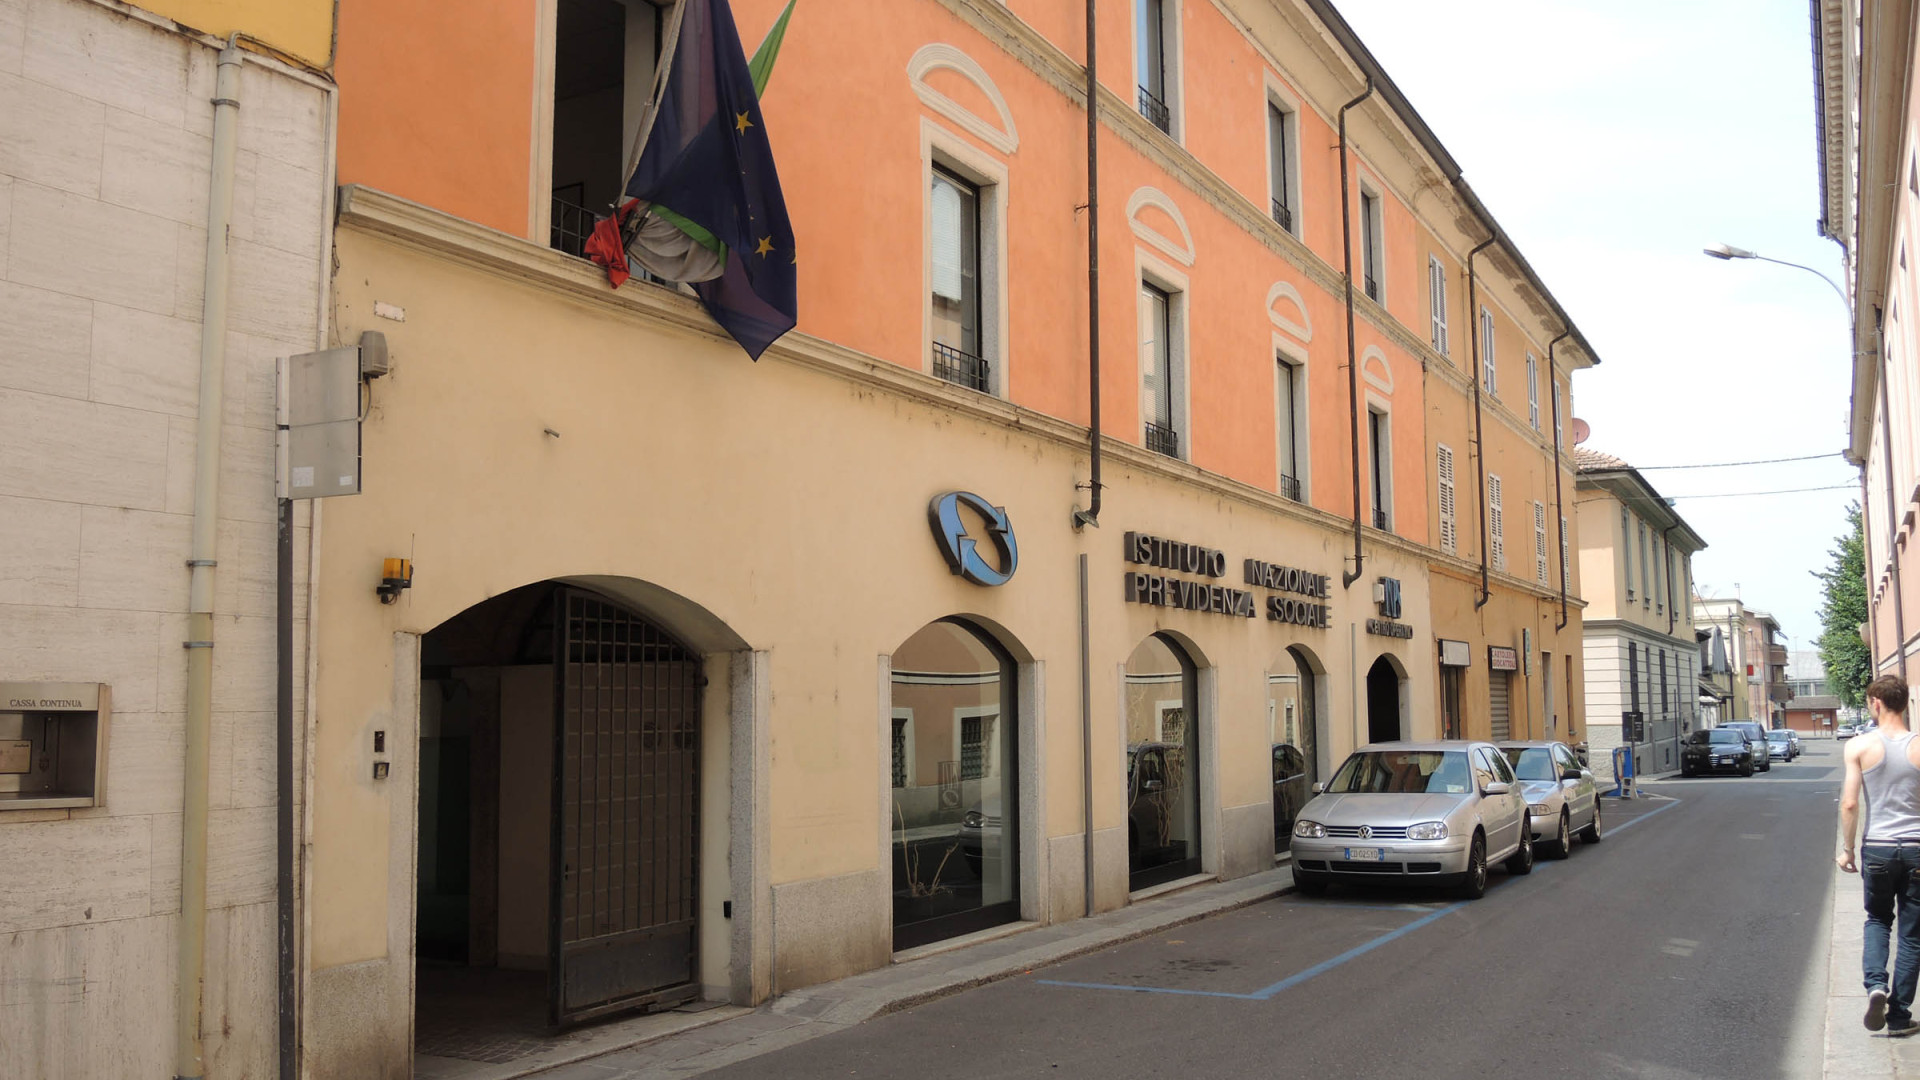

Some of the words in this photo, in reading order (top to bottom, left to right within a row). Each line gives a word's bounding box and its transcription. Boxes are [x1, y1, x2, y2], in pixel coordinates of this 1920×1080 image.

[1124, 531, 1226, 577] ISTITUTO
[1244, 558, 1332, 599] NAZIONALE
[1125, 572, 1257, 618] PREVIDENZA
[1266, 596, 1332, 629] SOCIALE
[9, 699, 36, 708] CASSA
[39, 699, 82, 708] CONTINUA
